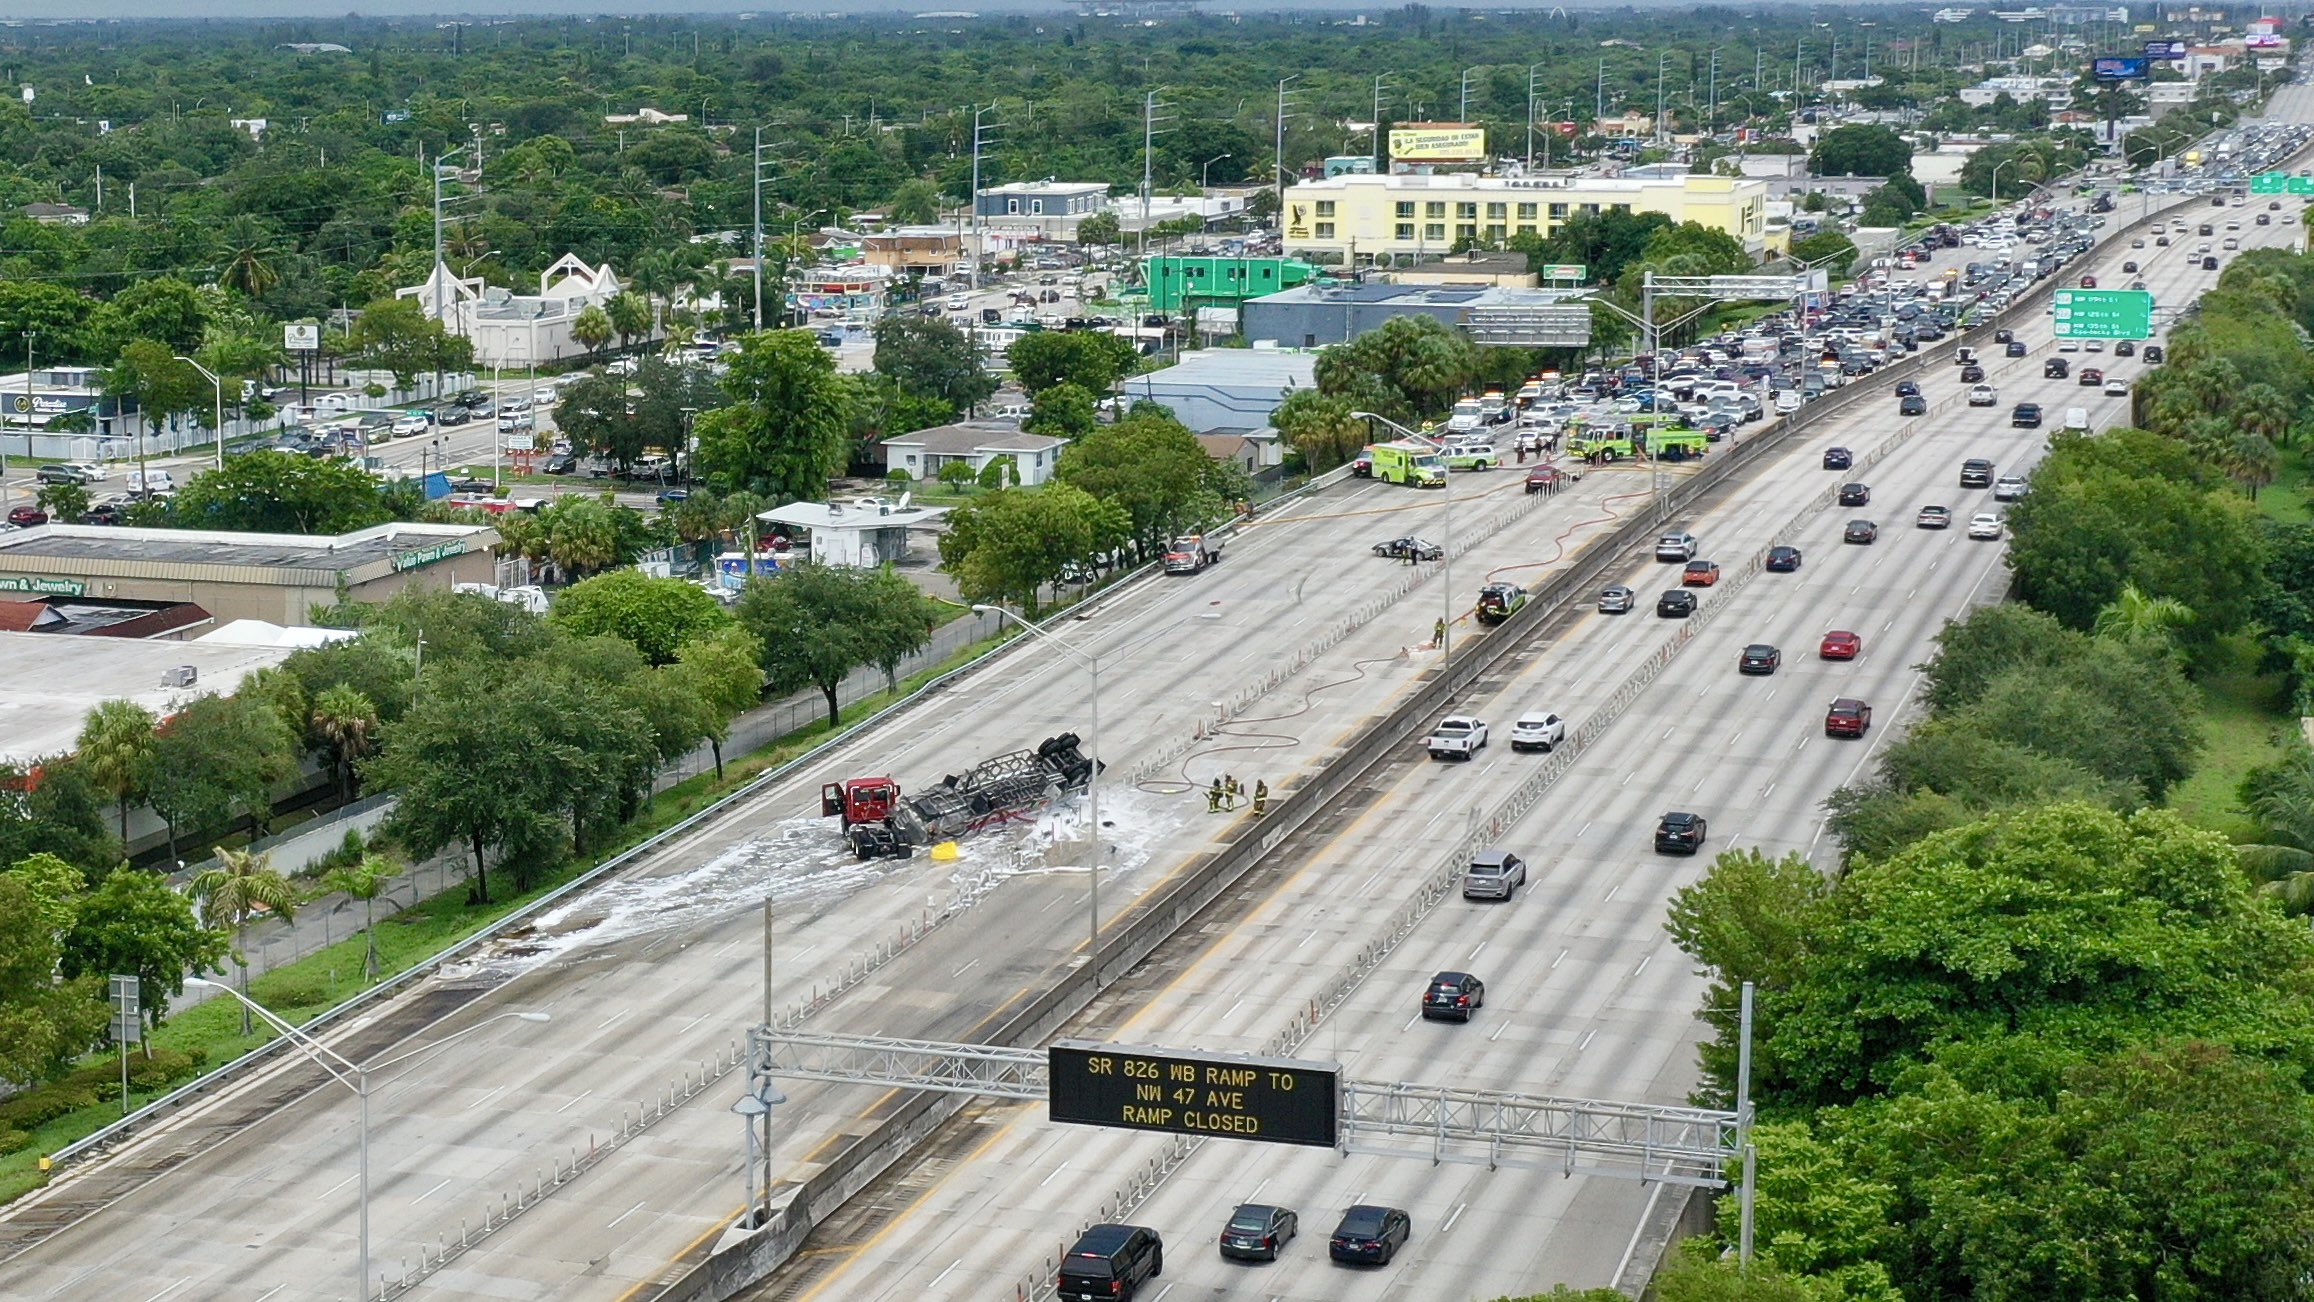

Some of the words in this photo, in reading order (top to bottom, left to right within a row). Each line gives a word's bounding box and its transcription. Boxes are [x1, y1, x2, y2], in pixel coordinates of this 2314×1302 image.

[1416, 135, 1449, 143] SEGURIDAD
[418, 551, 436, 564] Pawn
[442, 542, 466, 556] Jewelry
[20, 579, 29, 590] &
[33, 579, 82, 596] Jewelry
[1088, 1057, 1112, 1075] SR
[1124, 1061, 1159, 1079] 826
[1170, 1064, 1195, 1082] WB
[1206, 1068, 1256, 1088] RAMP
[1269, 1073, 1293, 1091] TO
[1136, 1083, 1162, 1102] NW
[1173, 1087, 1195, 1105] 47
[1206, 1091, 1244, 1110] AVE
[1123, 1105, 1173, 1126] RAMP
[1184, 1111, 1258, 1134] CLOSED
